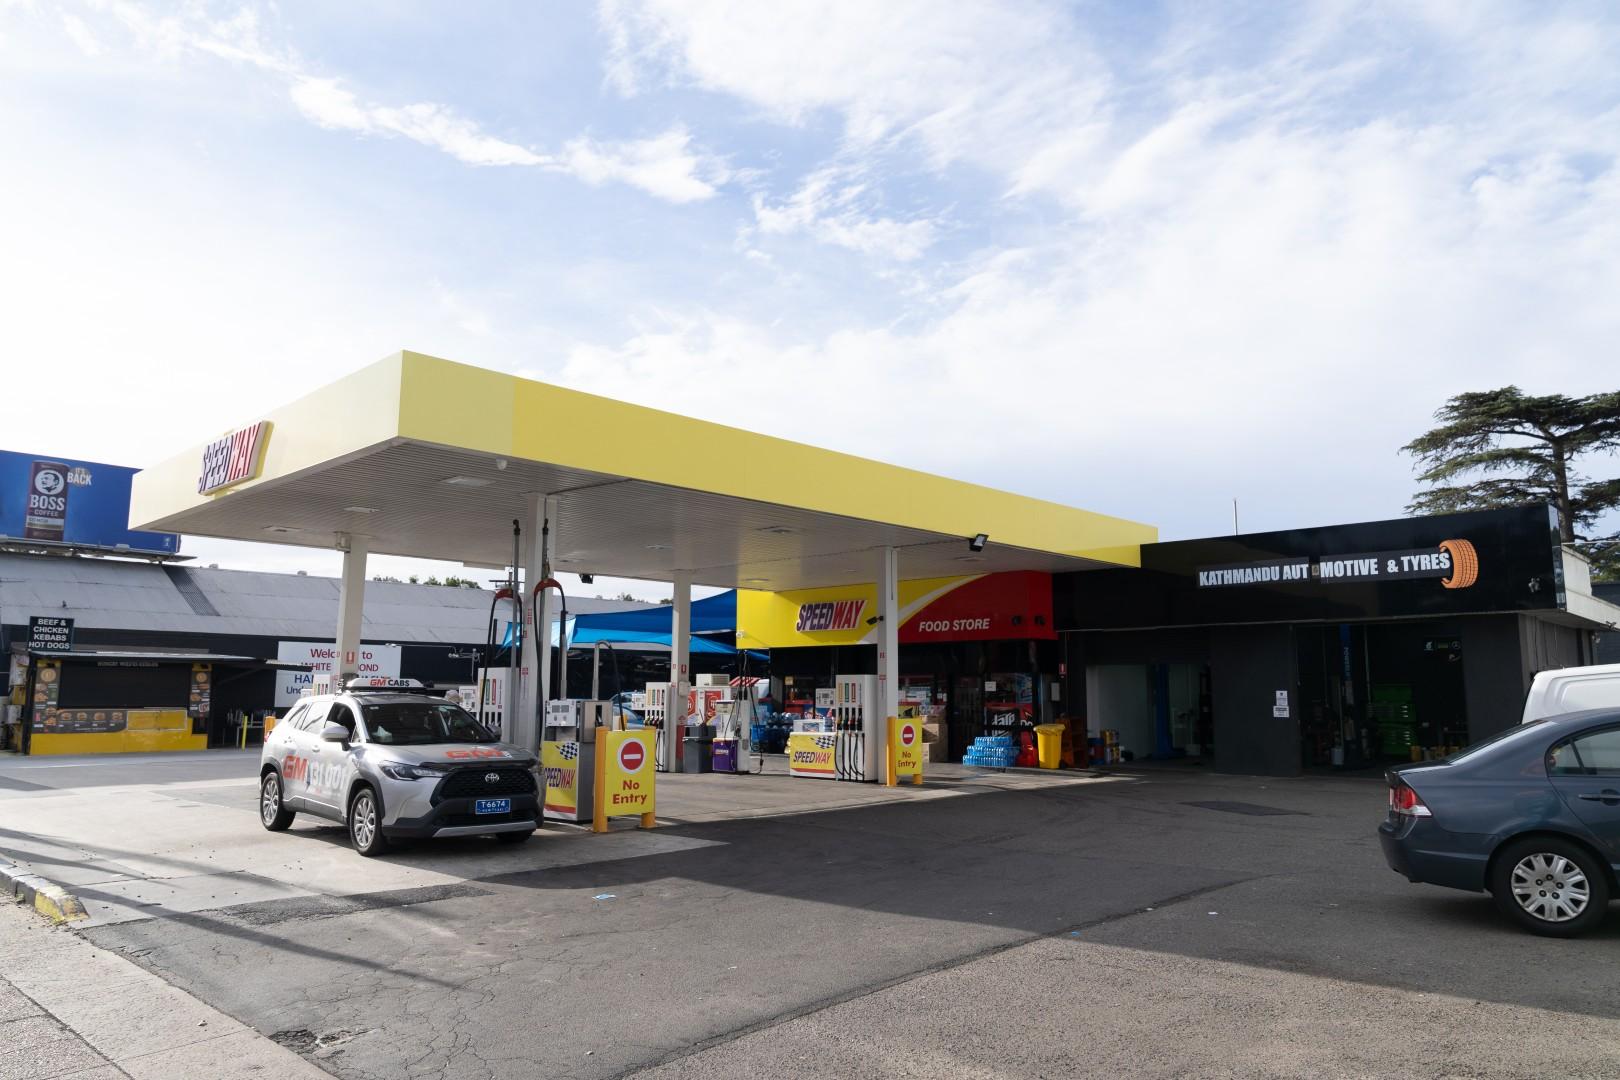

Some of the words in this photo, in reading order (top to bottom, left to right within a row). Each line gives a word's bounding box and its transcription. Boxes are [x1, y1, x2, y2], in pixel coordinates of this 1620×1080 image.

[198, 422, 261, 493] SPEEDWAY
[67, 472, 92, 486] BACK
[31, 495, 65, 511] BOSS
[34, 509, 59, 517] COFFEE
[1199, 566, 1280, 586] KATHMANDU
[1387, 559, 1399, 573] &
[1401, 552, 1451, 572] TYRES
[796, 600, 865, 632] SPEEDWAY
[38, 618, 59, 626] BEEF
[919, 620, 950, 632] FOOD
[953, 618, 990, 631] STORE
[33, 626, 69, 634] CHICKEN
[28, 641, 46, 649] HOT
[310, 648, 335, 659] Welc
[362, 651, 373, 659] to
[301, 662, 332, 671] HITE
[387, 679, 410, 687] CABS
[793, 751, 832, 764] SPEEDWAY
[902, 751, 912, 759] No
[283, 755, 308, 781] GM
[543, 767, 576, 788] PEEDWAY
[622, 780, 640, 791] No
[612, 794, 647, 805] Entry
